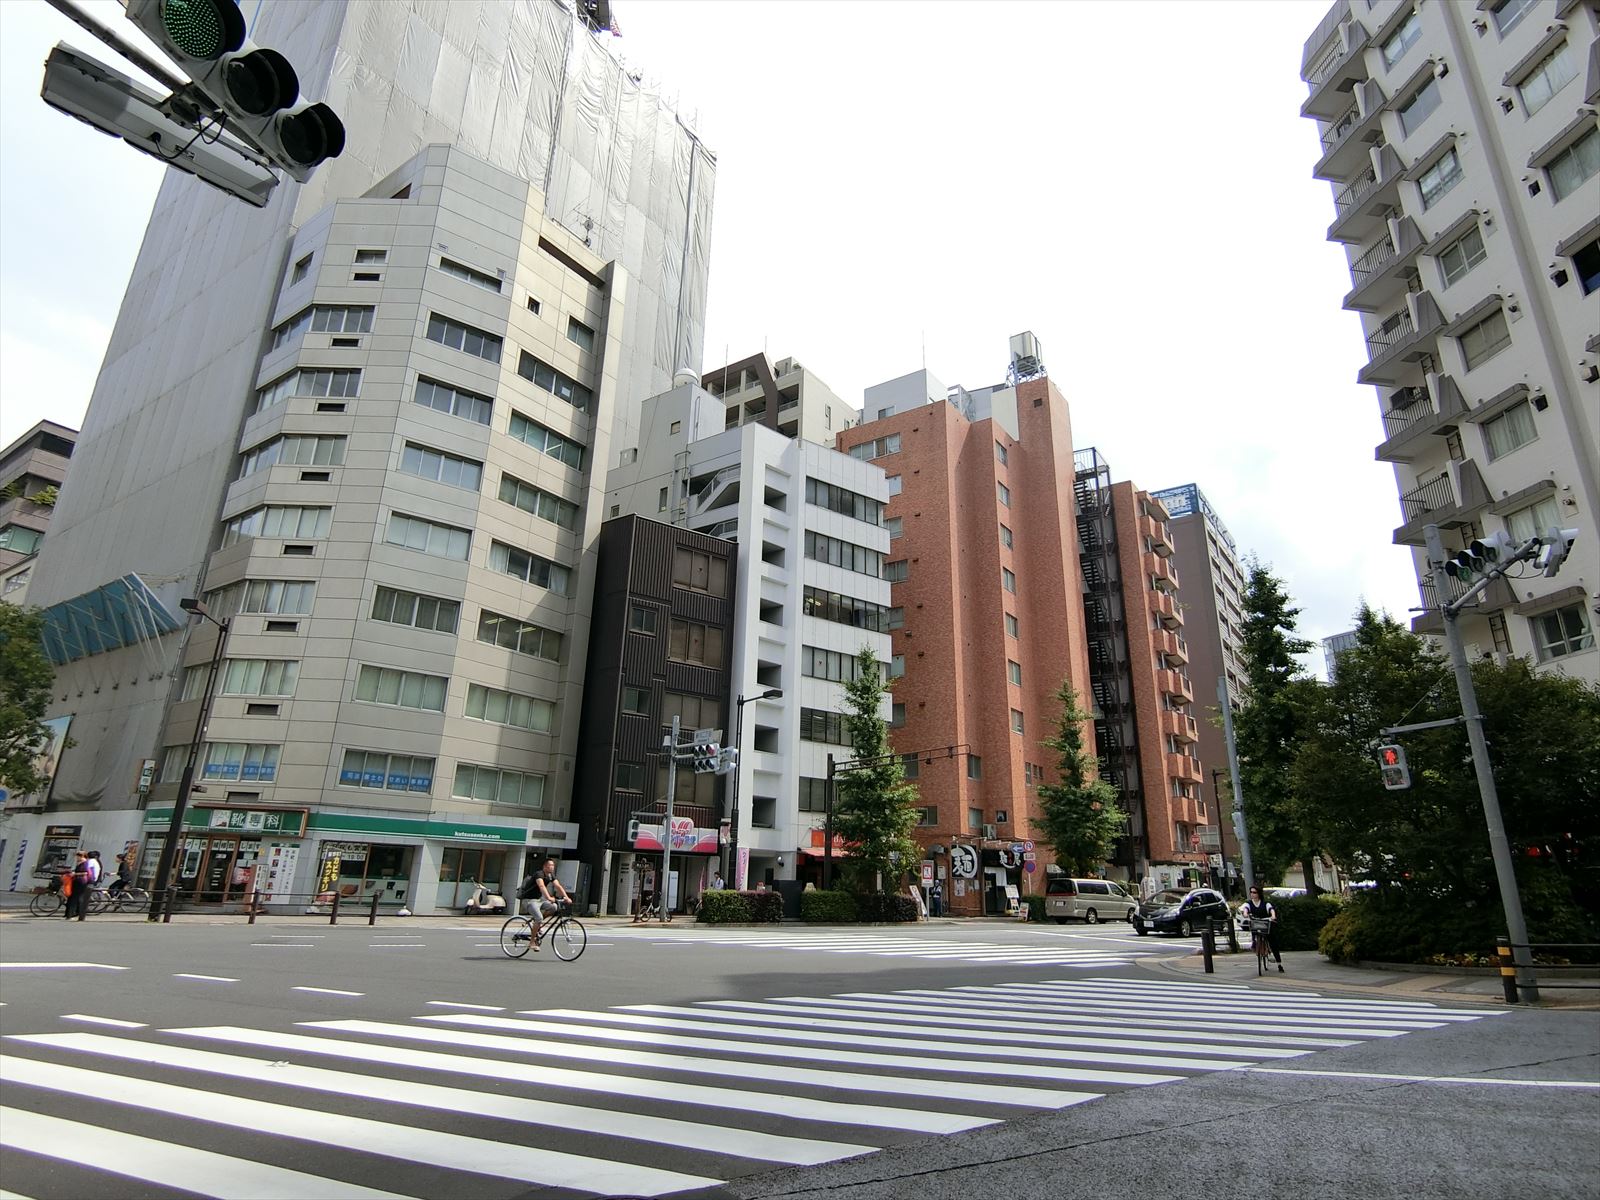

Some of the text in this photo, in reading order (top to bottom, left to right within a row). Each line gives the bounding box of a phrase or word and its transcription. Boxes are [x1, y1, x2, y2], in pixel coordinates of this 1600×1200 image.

[231, 811, 280, 828] 靴専科
[321, 861, 332, 892] スッキリ
[332, 857, 340, 881] カビも
